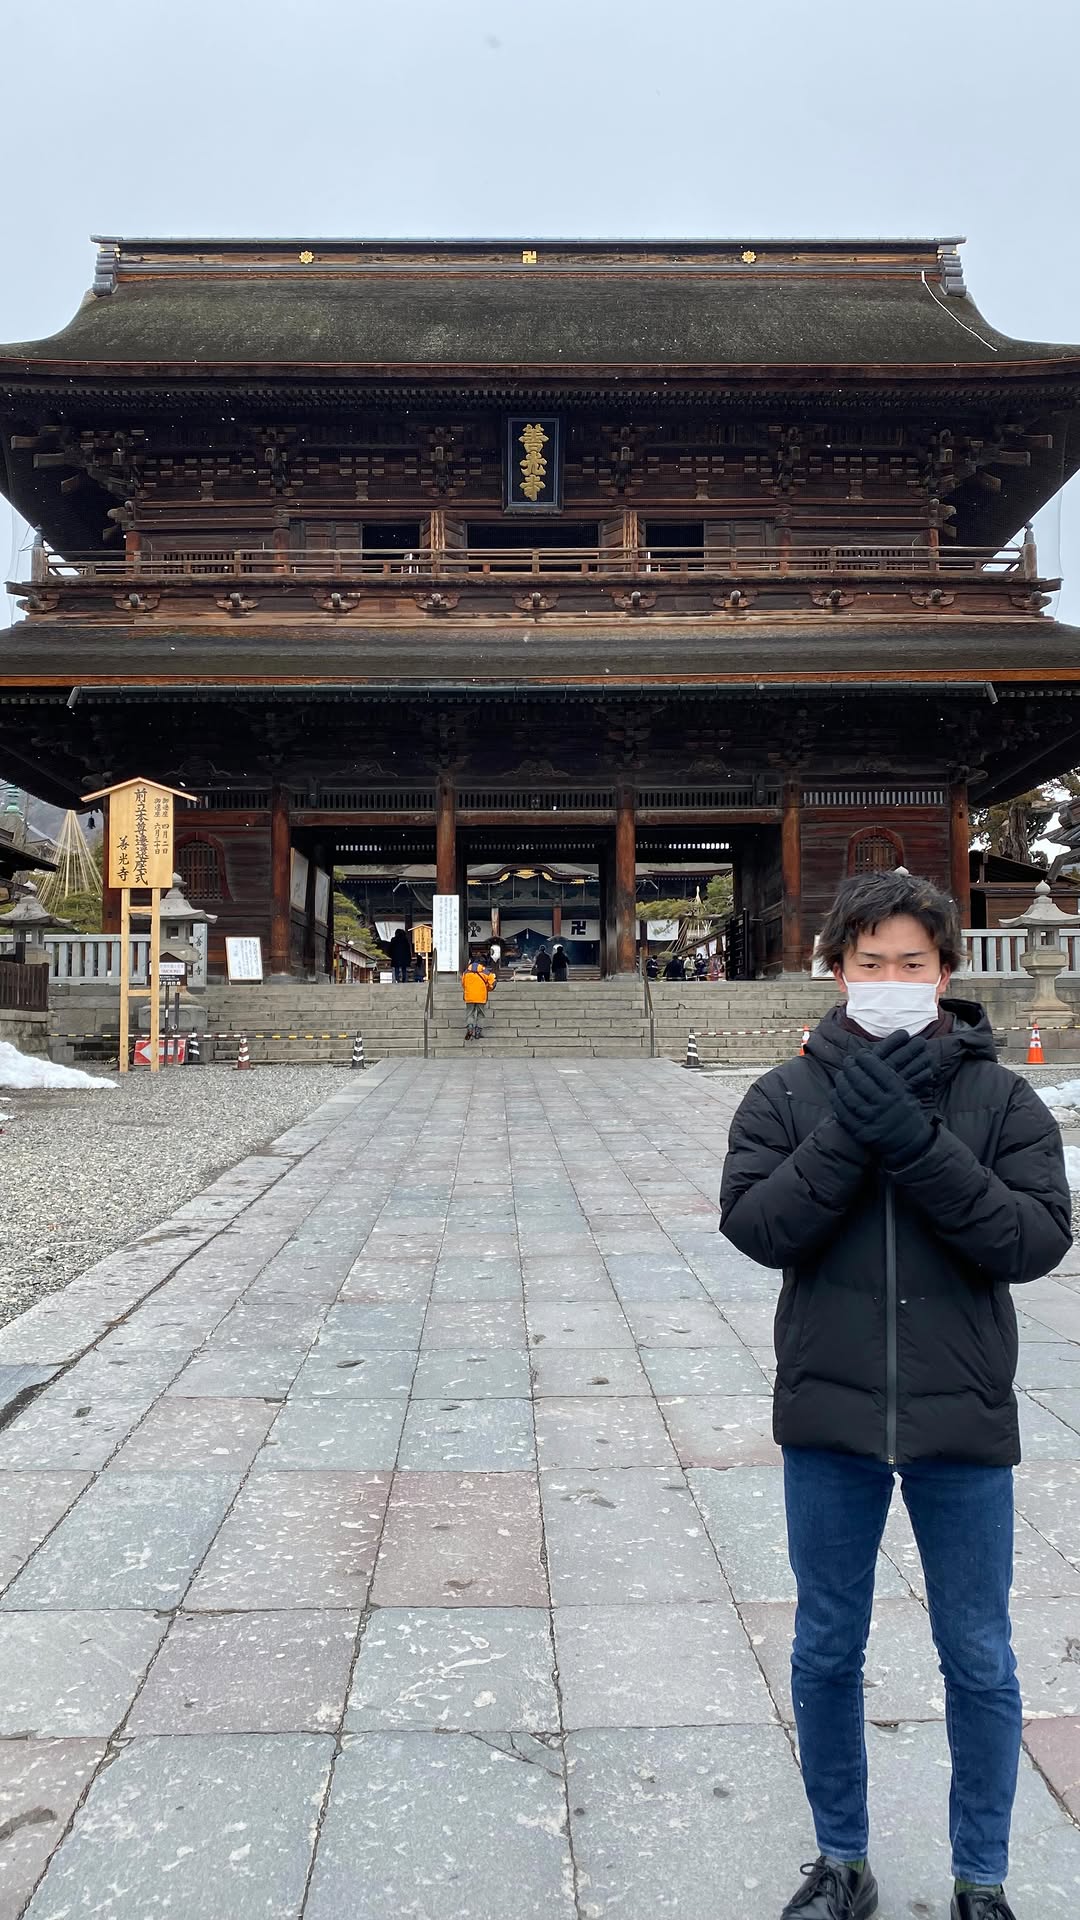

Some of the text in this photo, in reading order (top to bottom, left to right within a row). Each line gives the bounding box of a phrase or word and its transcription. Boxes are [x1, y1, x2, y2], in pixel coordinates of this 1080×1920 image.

[518, 423, 549, 501] 善光寺
[117, 835, 130, 882] 善光寺
